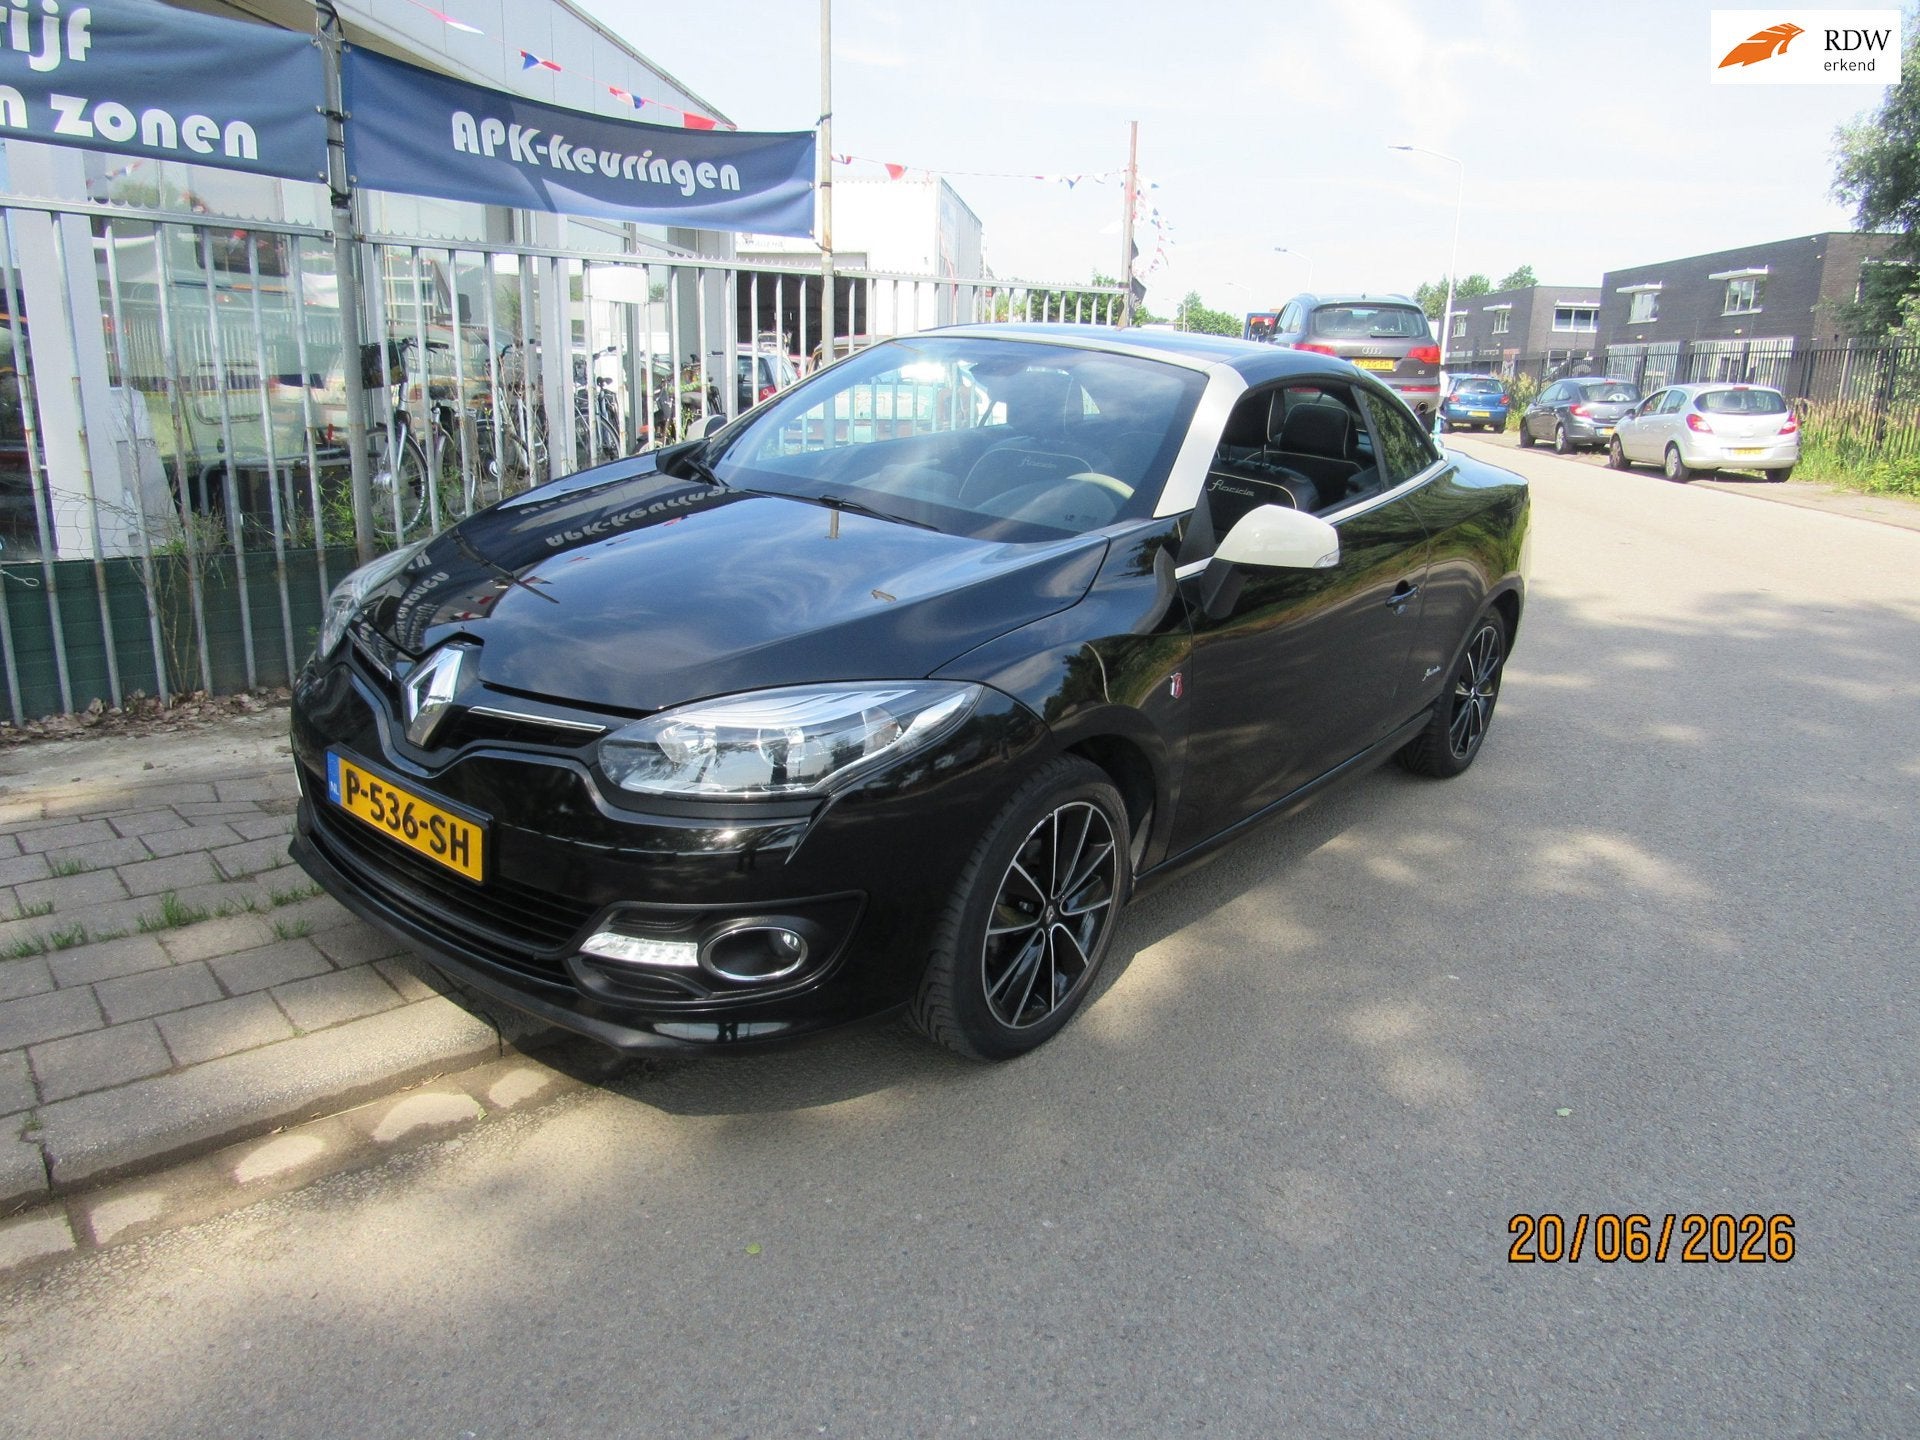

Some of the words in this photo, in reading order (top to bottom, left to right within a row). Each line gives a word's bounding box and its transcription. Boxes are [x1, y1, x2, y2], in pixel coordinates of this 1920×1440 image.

[50, 93, 258, 160] zonen
[452, 111, 740, 197] APK-keuringen
[345, 768, 469, 868] P-536-SH
